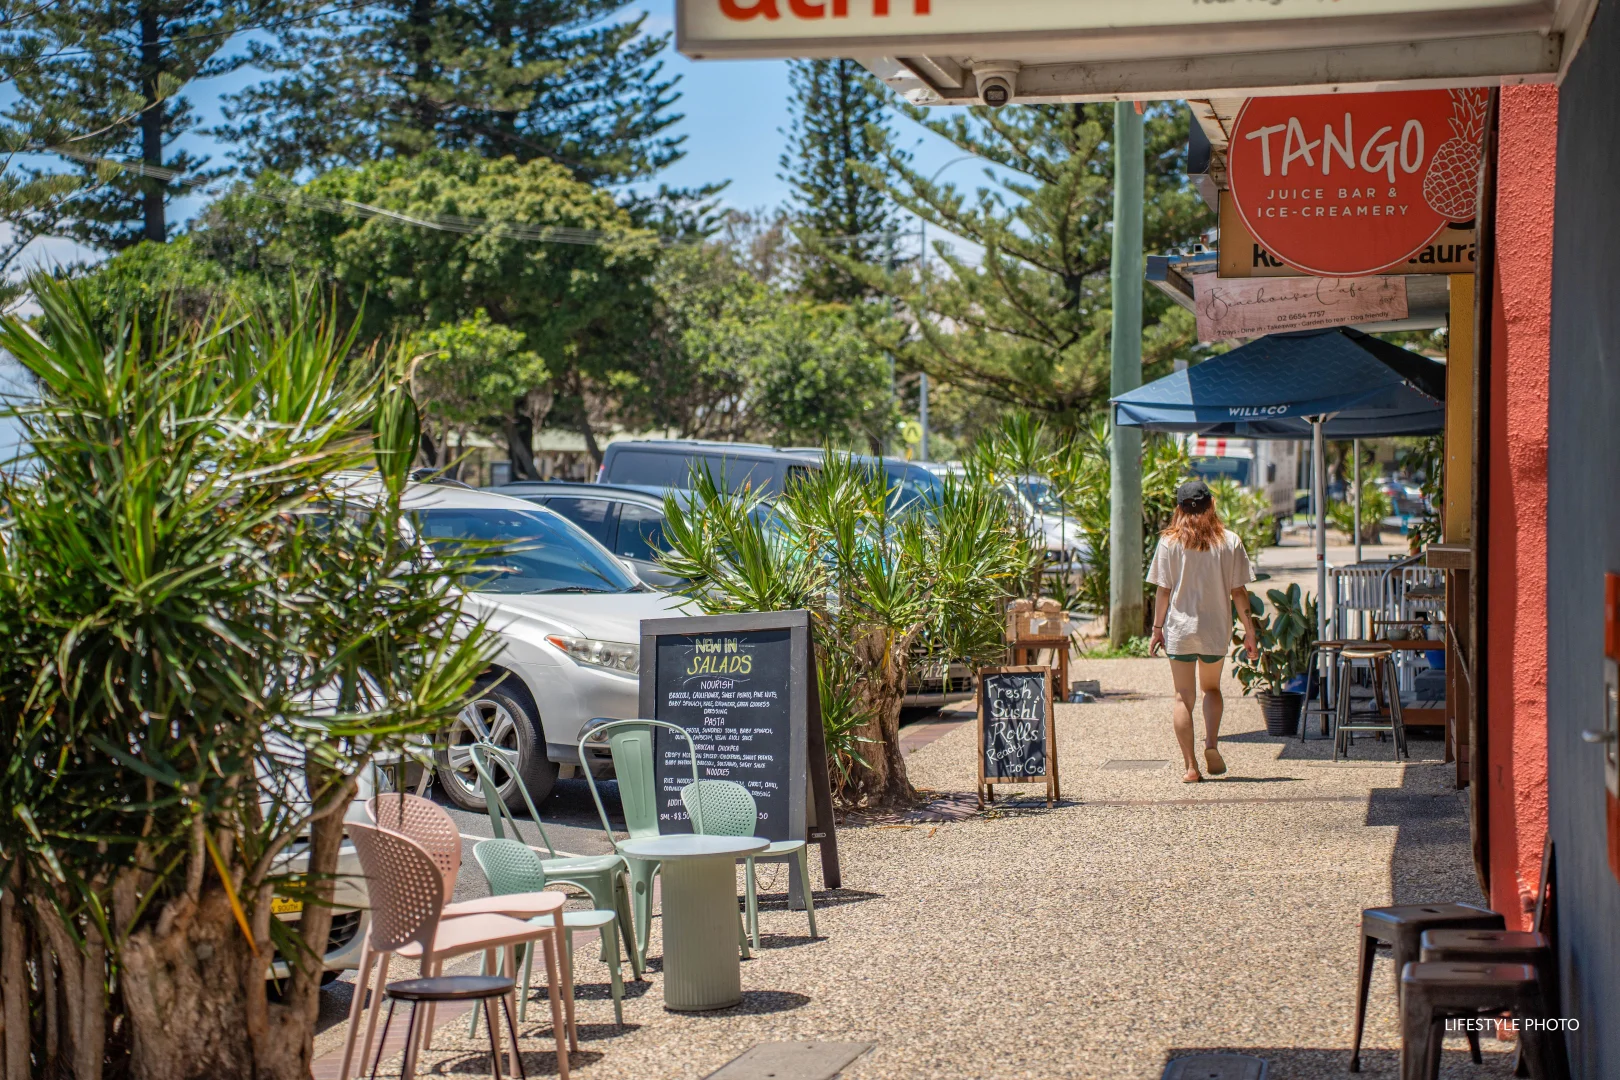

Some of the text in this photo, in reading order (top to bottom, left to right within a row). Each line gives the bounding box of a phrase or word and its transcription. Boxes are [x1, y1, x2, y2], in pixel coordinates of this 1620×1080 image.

[1245, 112, 1425, 184] TANGO
[1267, 187, 1398, 200] JUICE BAR &
[1257, 204, 1410, 218] ICE-CREAMERY
[1308, 310, 1326, 318] 7757
[695, 637, 738, 654] NEW IN
[686, 654, 753, 675] SALADS
[700, 680, 734, 690] NOURISH
[985, 675, 1032, 699] Fresh
[990, 696, 1039, 719] Sushi
[704, 716, 726, 727] PASTA
[990, 721, 1039, 746] Rolls
[986, 742, 1025, 765] Ready
[706, 767, 730, 777] NOODLES
[1006, 757, 1046, 775] to Go!
